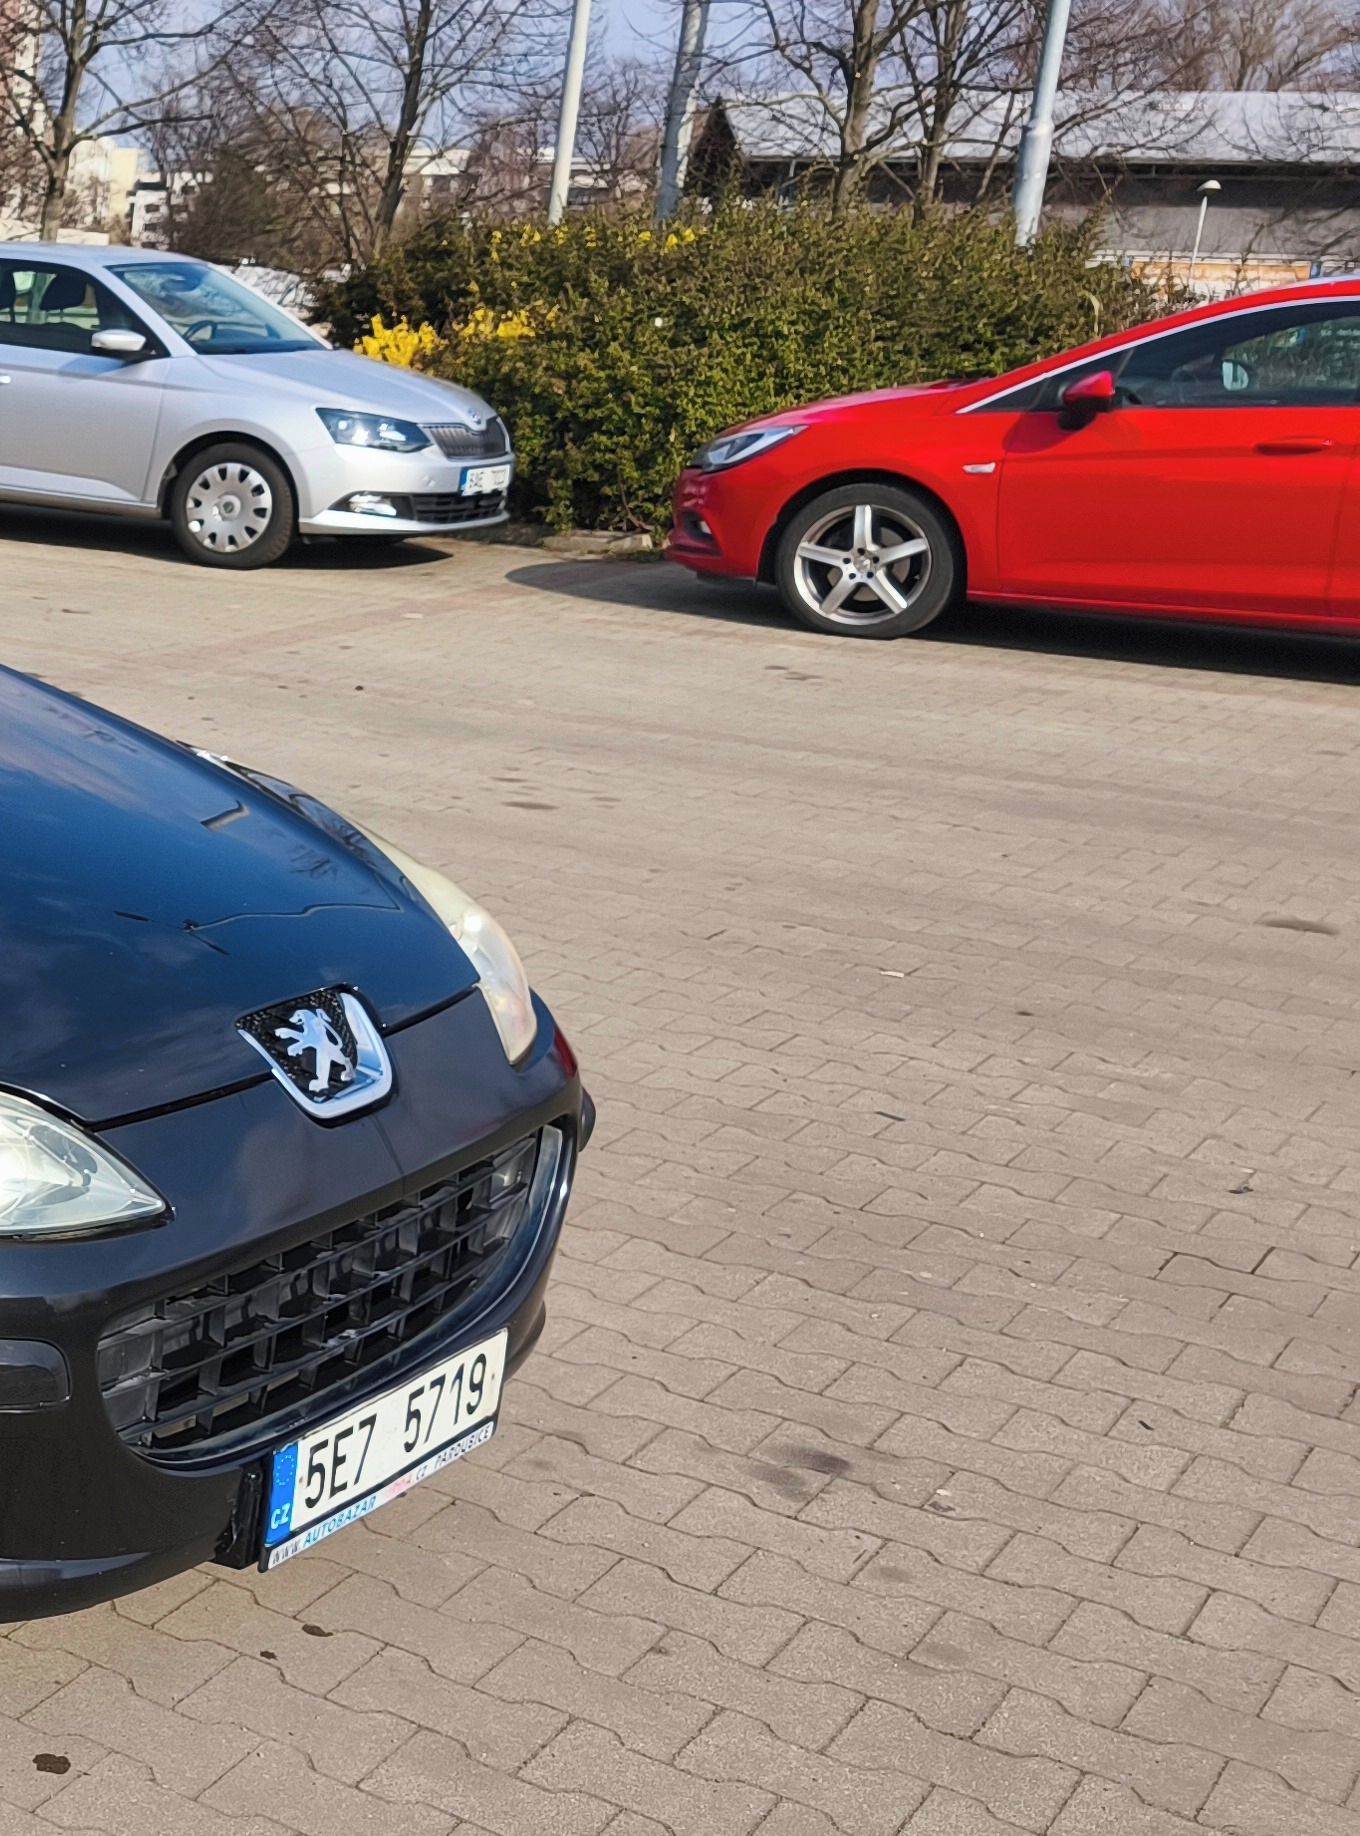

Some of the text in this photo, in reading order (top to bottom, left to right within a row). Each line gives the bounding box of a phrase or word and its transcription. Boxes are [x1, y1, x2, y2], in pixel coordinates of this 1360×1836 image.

[305, 1353, 487, 1509] 5E7 5719
[270, 1503, 291, 1530] CZ
